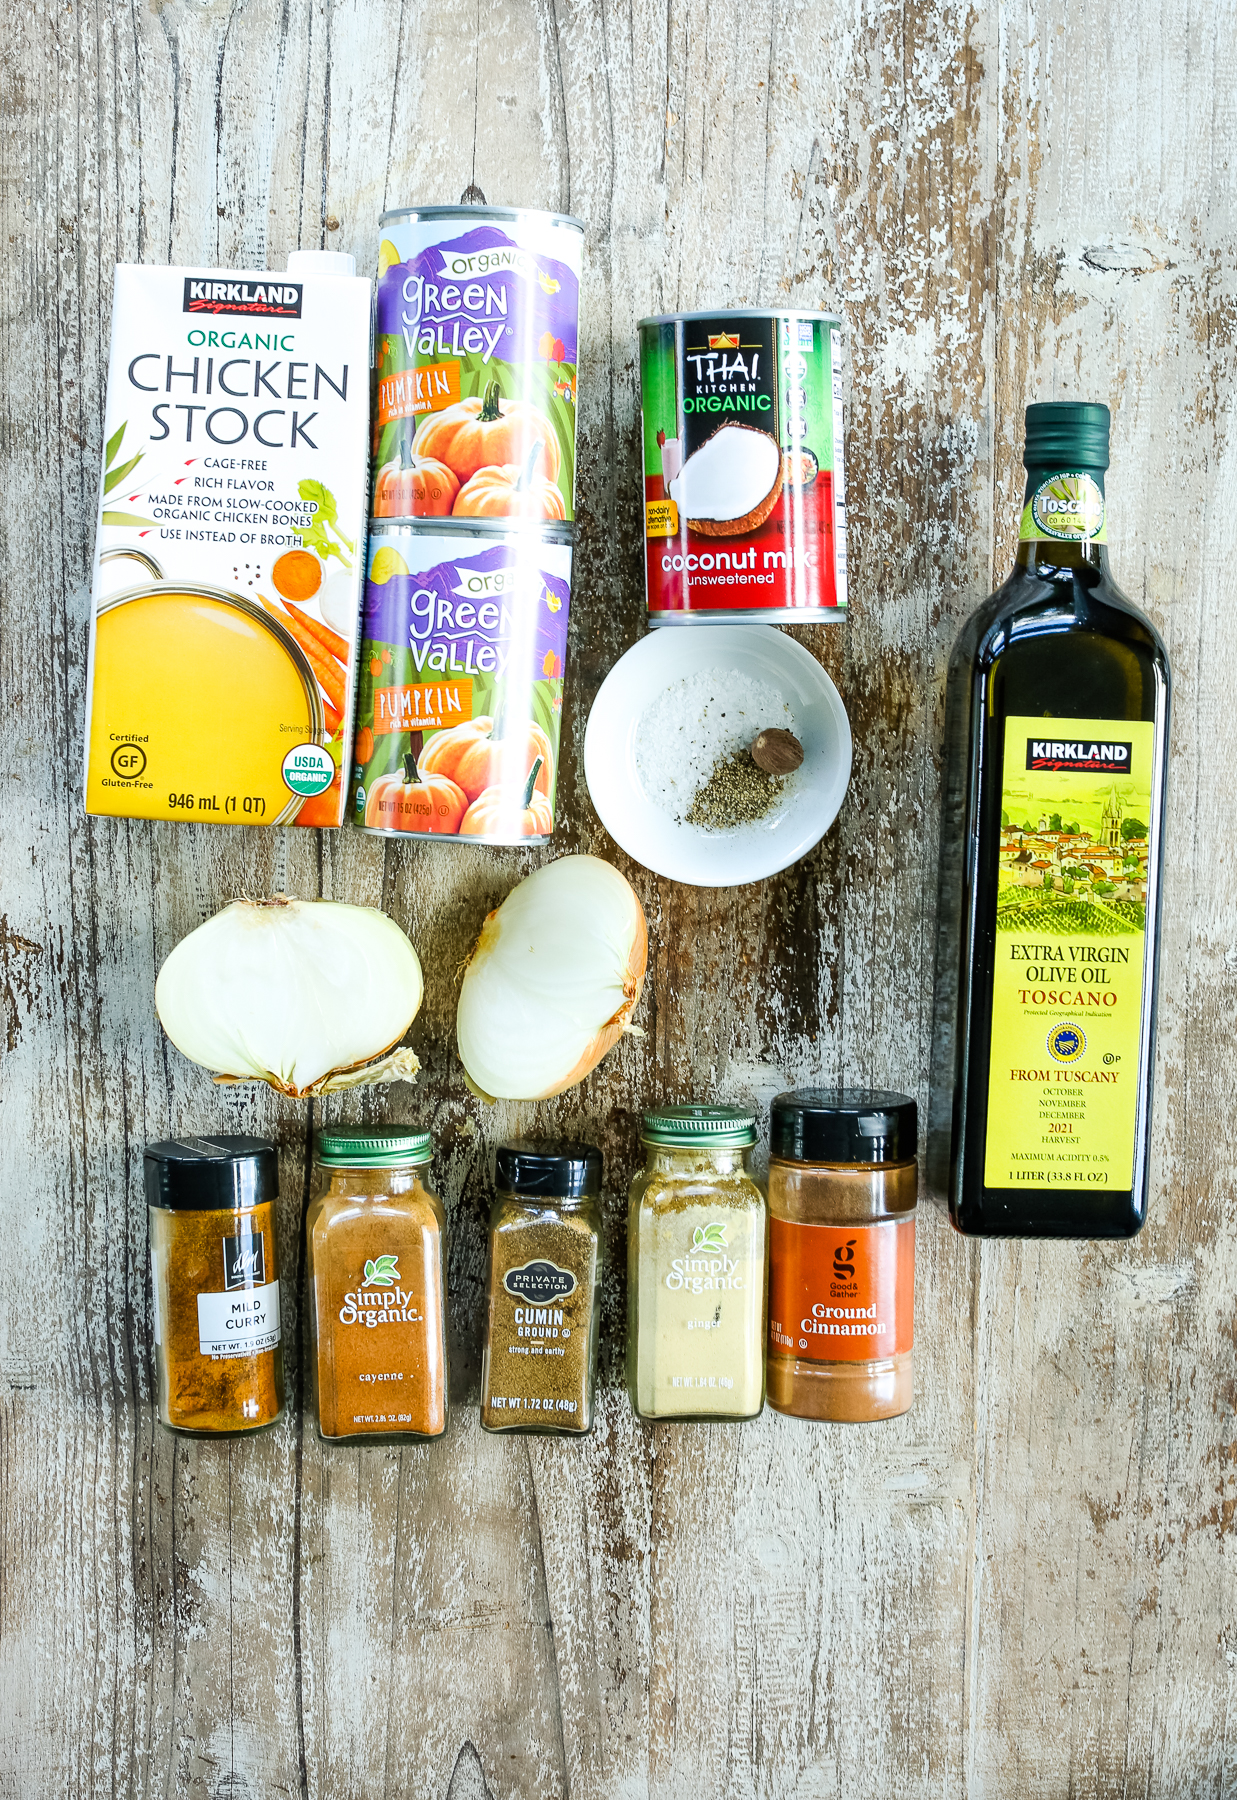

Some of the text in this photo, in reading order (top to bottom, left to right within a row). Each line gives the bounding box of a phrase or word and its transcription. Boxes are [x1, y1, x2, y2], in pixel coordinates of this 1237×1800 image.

[190, 281, 298, 304] KIRKLAND
[189, 299, 297, 315] Signature
[187, 330, 295, 351] ORGANIC
[687, 352, 760, 382] THAI
[128, 354, 349, 401] CHICKEN
[382, 370, 450, 409] PUMPKIN
[696, 383, 756, 394] KITCHEN
[404, 401, 427, 413] vitamin
[682, 394, 771, 414] ORGANIC
[150, 403, 319, 449] STOCK
[204, 457, 267, 471] CAGE-FREE
[194, 477, 275, 491] RICH FLAVOR
[148, 494, 318, 513] MADE FROM SLOW-COOKED
[1040, 496, 1101, 516] Toscao
[153, 508, 312, 527] ORGANIC CHICKEN BONES
[160, 529, 303, 547] USE INSTEAD OF BROTH
[661, 548, 757, 573] coconut
[763, 547, 811, 569] mik
[687, 572, 774, 586] unsweetened
[380, 687, 461, 719] PUMPKIN
[279, 723, 304, 735] Serving
[410, 717, 435, 728] vitamin
[436, 716, 442, 726] A
[109, 733, 149, 743] Certified
[1032, 742, 1127, 761] KIRKLAND
[118, 755, 138, 767] GF
[294, 756, 323, 768] USDA
[1032, 757, 1127, 771] Signature
[101, 778, 153, 789] Gluten-Free
[290, 772, 327, 783] ORGANIC
[168, 794, 266, 815] 946 mL (1 QT)
[379, 801, 387, 811] NET
[397, 803, 404, 813] 15
[405, 803, 412, 813] OZ
[414, 804, 432, 816] (425g)
[1010, 944, 1129, 963] EXTRA VIRGIN
[1026, 966, 1111, 983] OLIVE OIL
[1018, 990, 1117, 1007] TOSCANO
[1050, 1010, 1083, 1018] Geographical
[1010, 1070, 1120, 1083] FROM TUSCANY
[1043, 1088, 1083, 1096] OCTOBER
[1039, 1100, 1086, 1108] NOVEMBER
[1039, 1111, 1085, 1119] DECEMBER
[1048, 1123, 1073, 1133] 2021
[1041, 1136, 1081, 1144] HARVEST
[1011, 1153, 1110, 1162] MAXIMUM ACIDITY 0.5%
[1009, 1171, 1108, 1184] 1 LITER (33.8 FL OZ)
[672, 1254, 739, 1277] Simply
[513, 1282, 567, 1290] SELECTION
[515, 1274, 564, 1284] PRIVATE
[344, 1286, 413, 1313] Simply
[830, 1290, 858, 1298] Gather
[232, 1300, 261, 1313] MILD
[811, 1303, 877, 1319] Ground
[226, 1313, 266, 1329] CURRY
[514, 1308, 563, 1325] CUMIN
[517, 1326, 558, 1338] GROUND
[687, 1320, 722, 1330] ginger
[800, 1319, 886, 1336] Cinnamon
[212, 1344, 227, 1352] NET
[229, 1343, 242, 1351] WT.
[509, 1346, 565, 1357] strong and earthy
[359, 1373, 404, 1384] cayenne
[672, 1376, 682, 1387] NET
[491, 1396, 577, 1412] NET WT 1.72 OZ (48g)
[353, 1415, 364, 1423] NET
